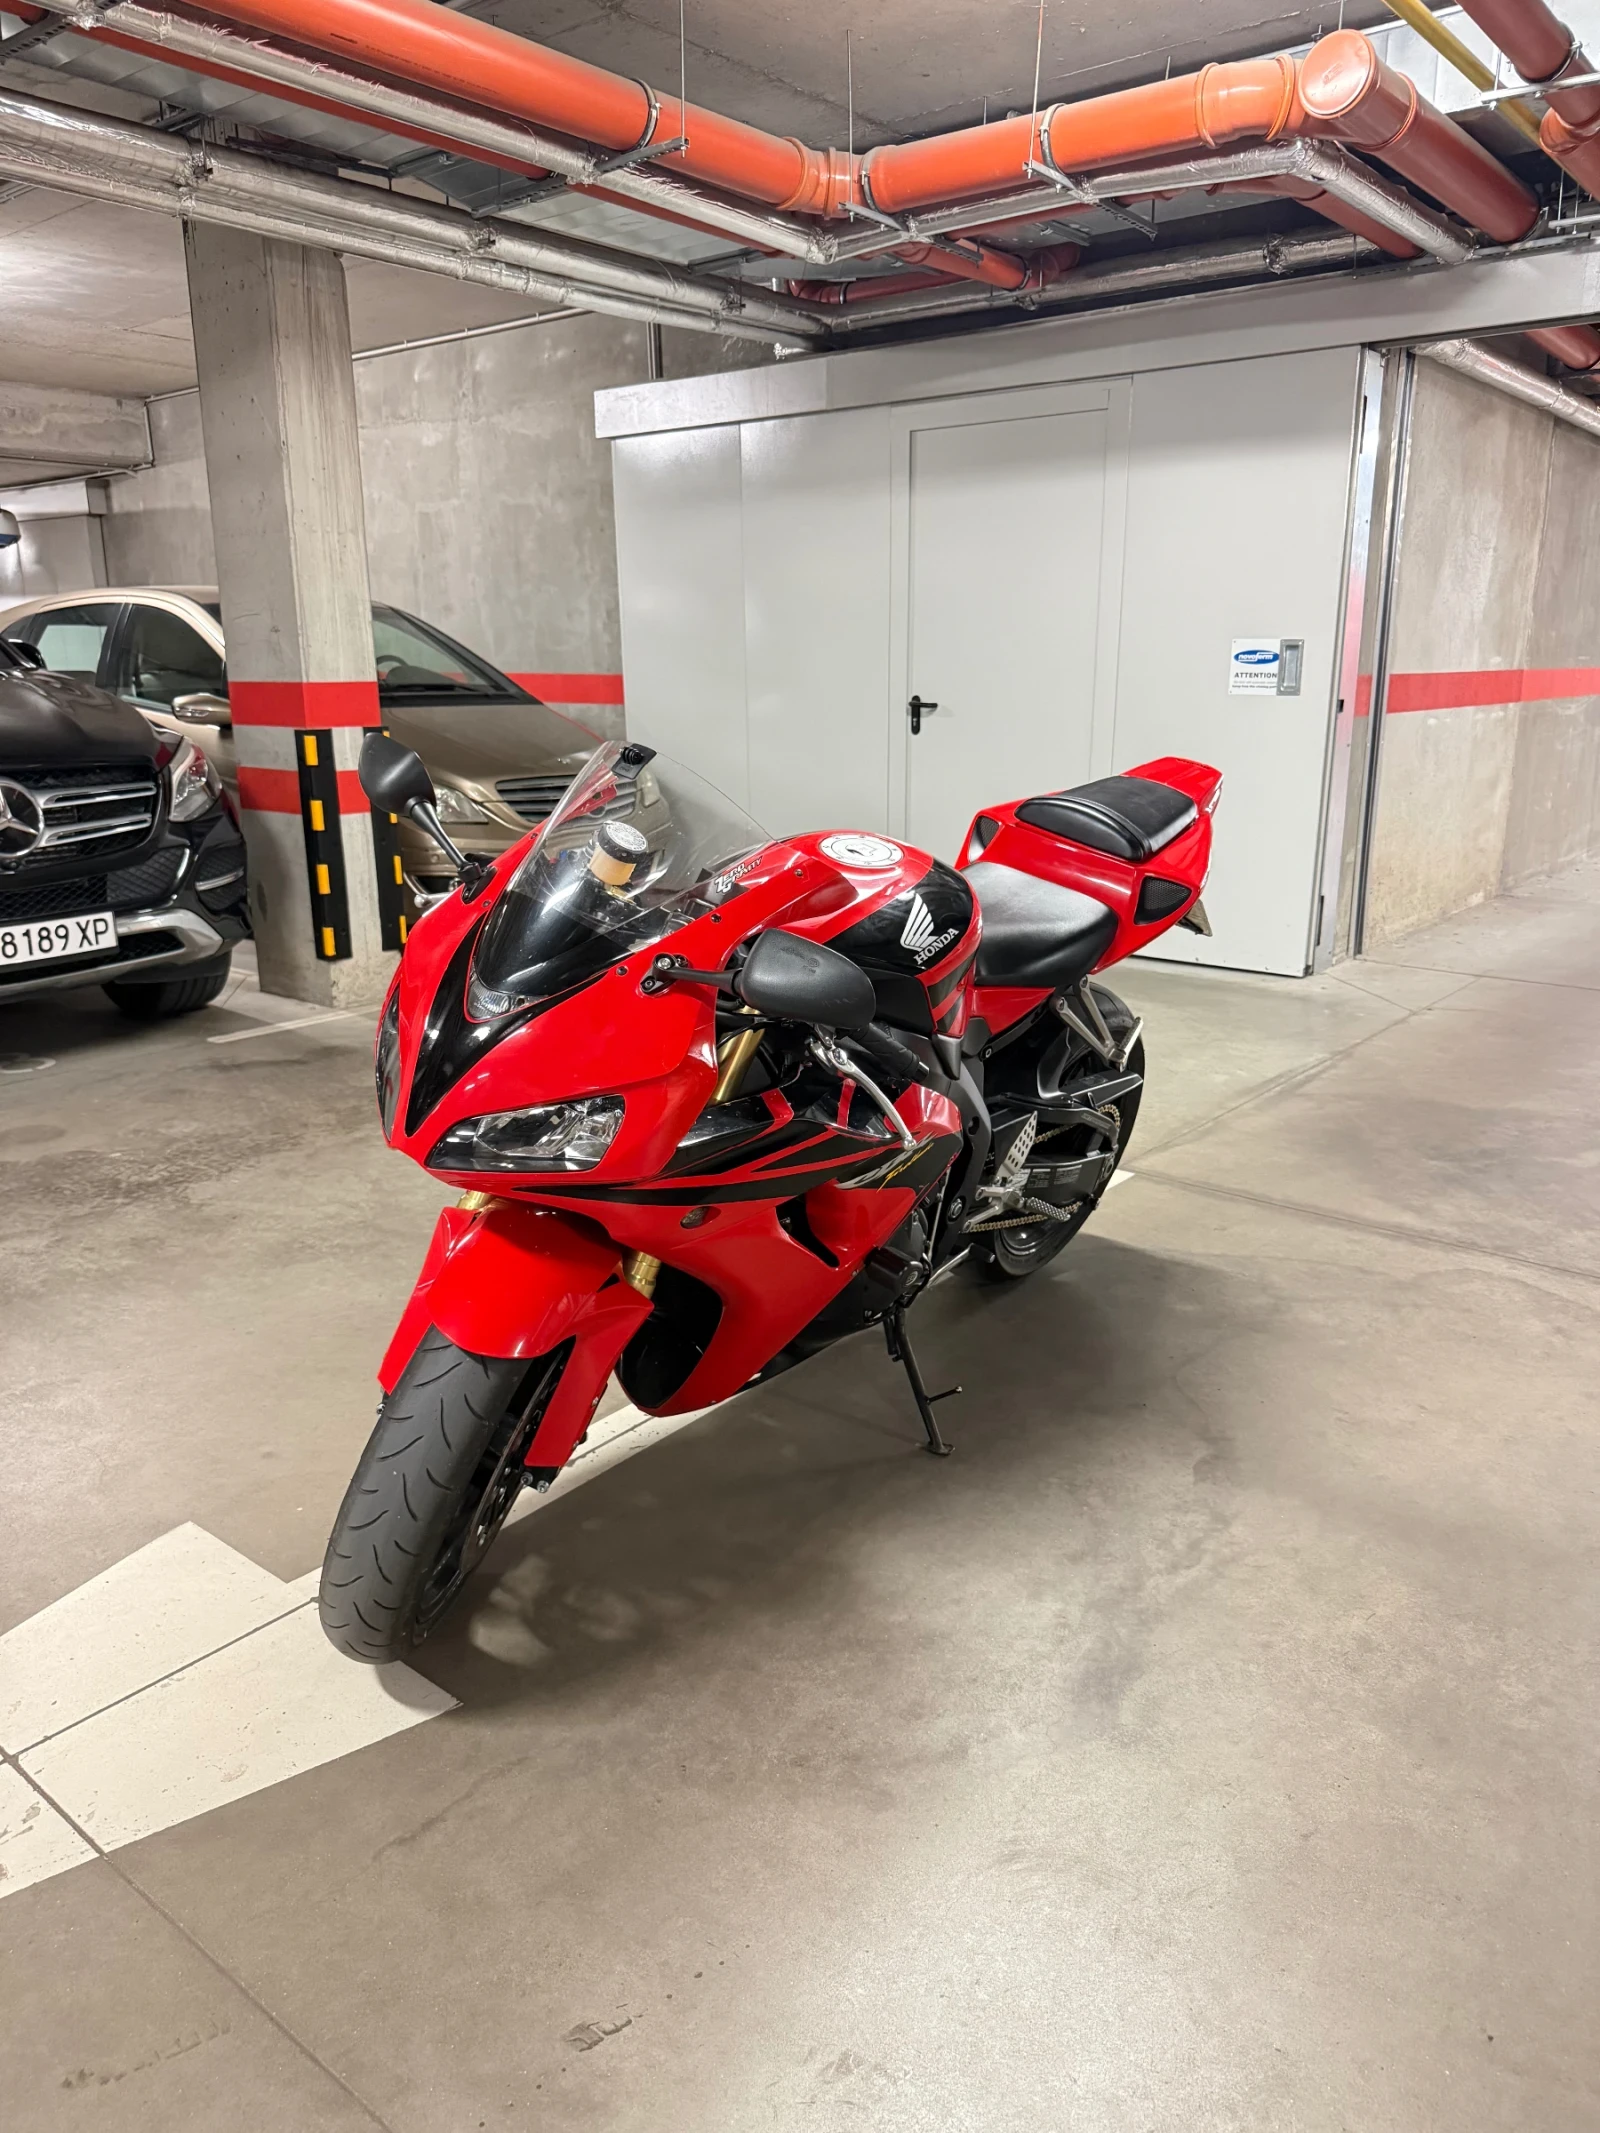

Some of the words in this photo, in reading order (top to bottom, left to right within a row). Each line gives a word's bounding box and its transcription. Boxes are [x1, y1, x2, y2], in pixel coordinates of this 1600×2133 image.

[1, 924, 70, 959] 8189
[76, 918, 109, 949] XP
[913, 928, 960, 965] HONDA
